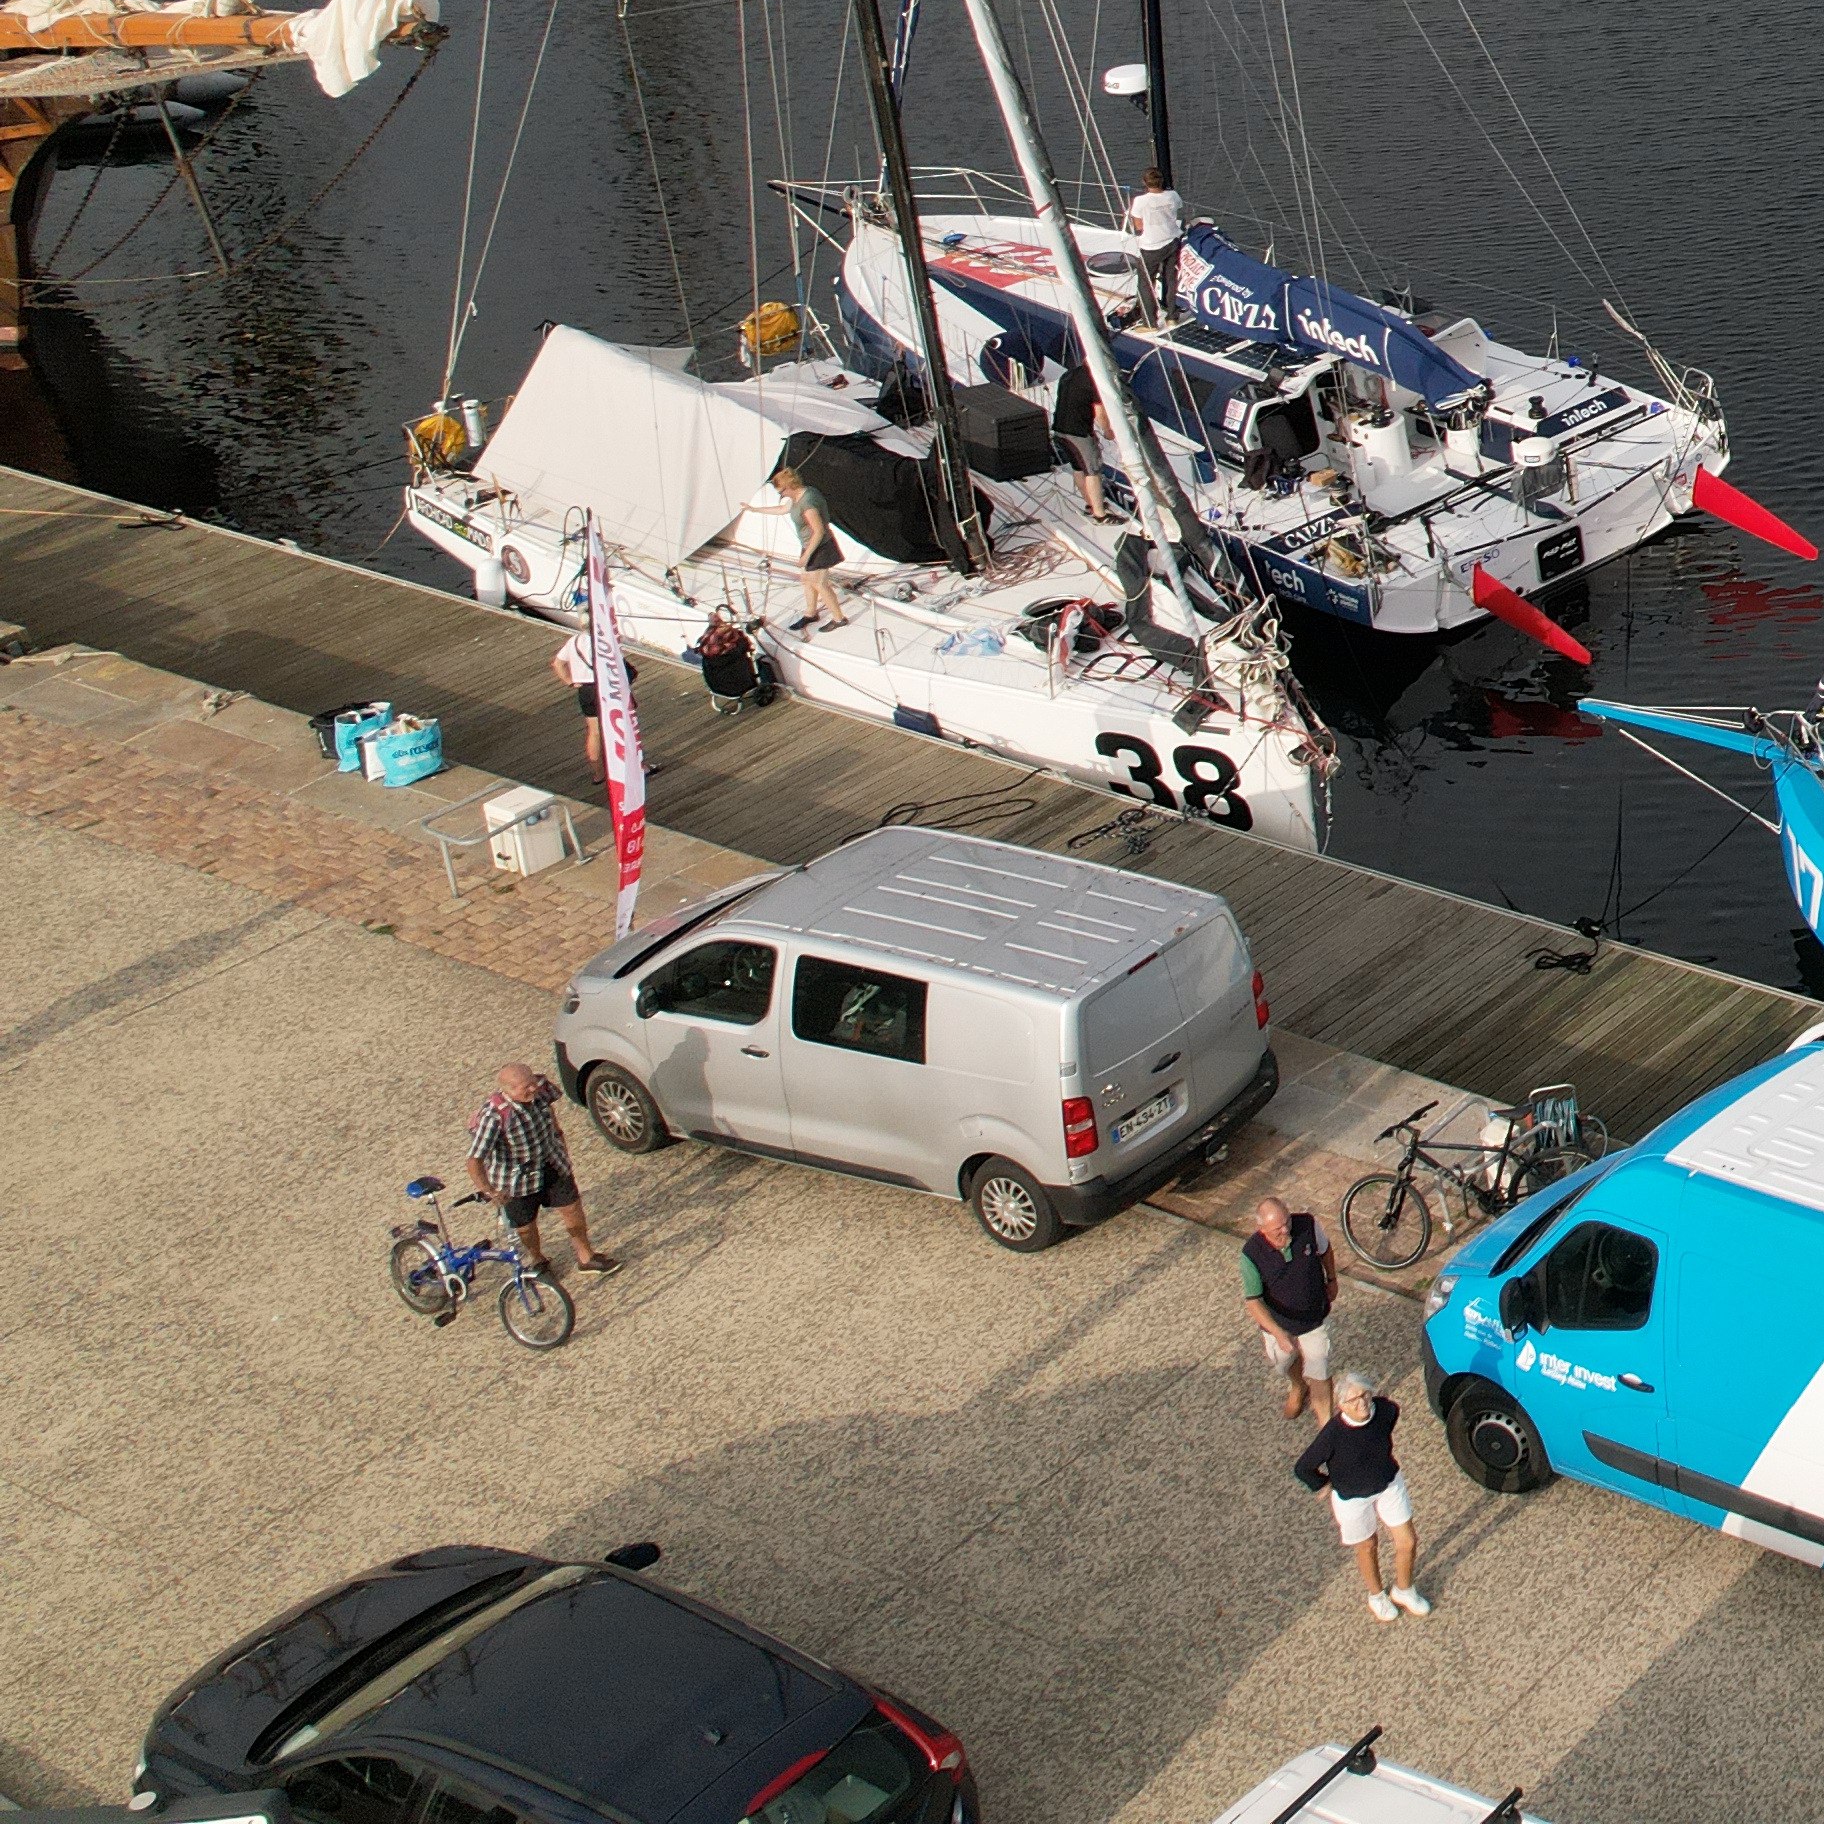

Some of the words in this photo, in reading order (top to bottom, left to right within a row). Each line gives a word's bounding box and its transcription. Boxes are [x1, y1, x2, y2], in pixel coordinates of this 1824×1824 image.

[1297, 308, 1380, 366] intech
[1561, 399, 1608, 428] intech
[1095, 732, 1253, 832] 38
[1539, 1351, 1571, 1374] inter
[1574, 1364, 1618, 1393] invest
